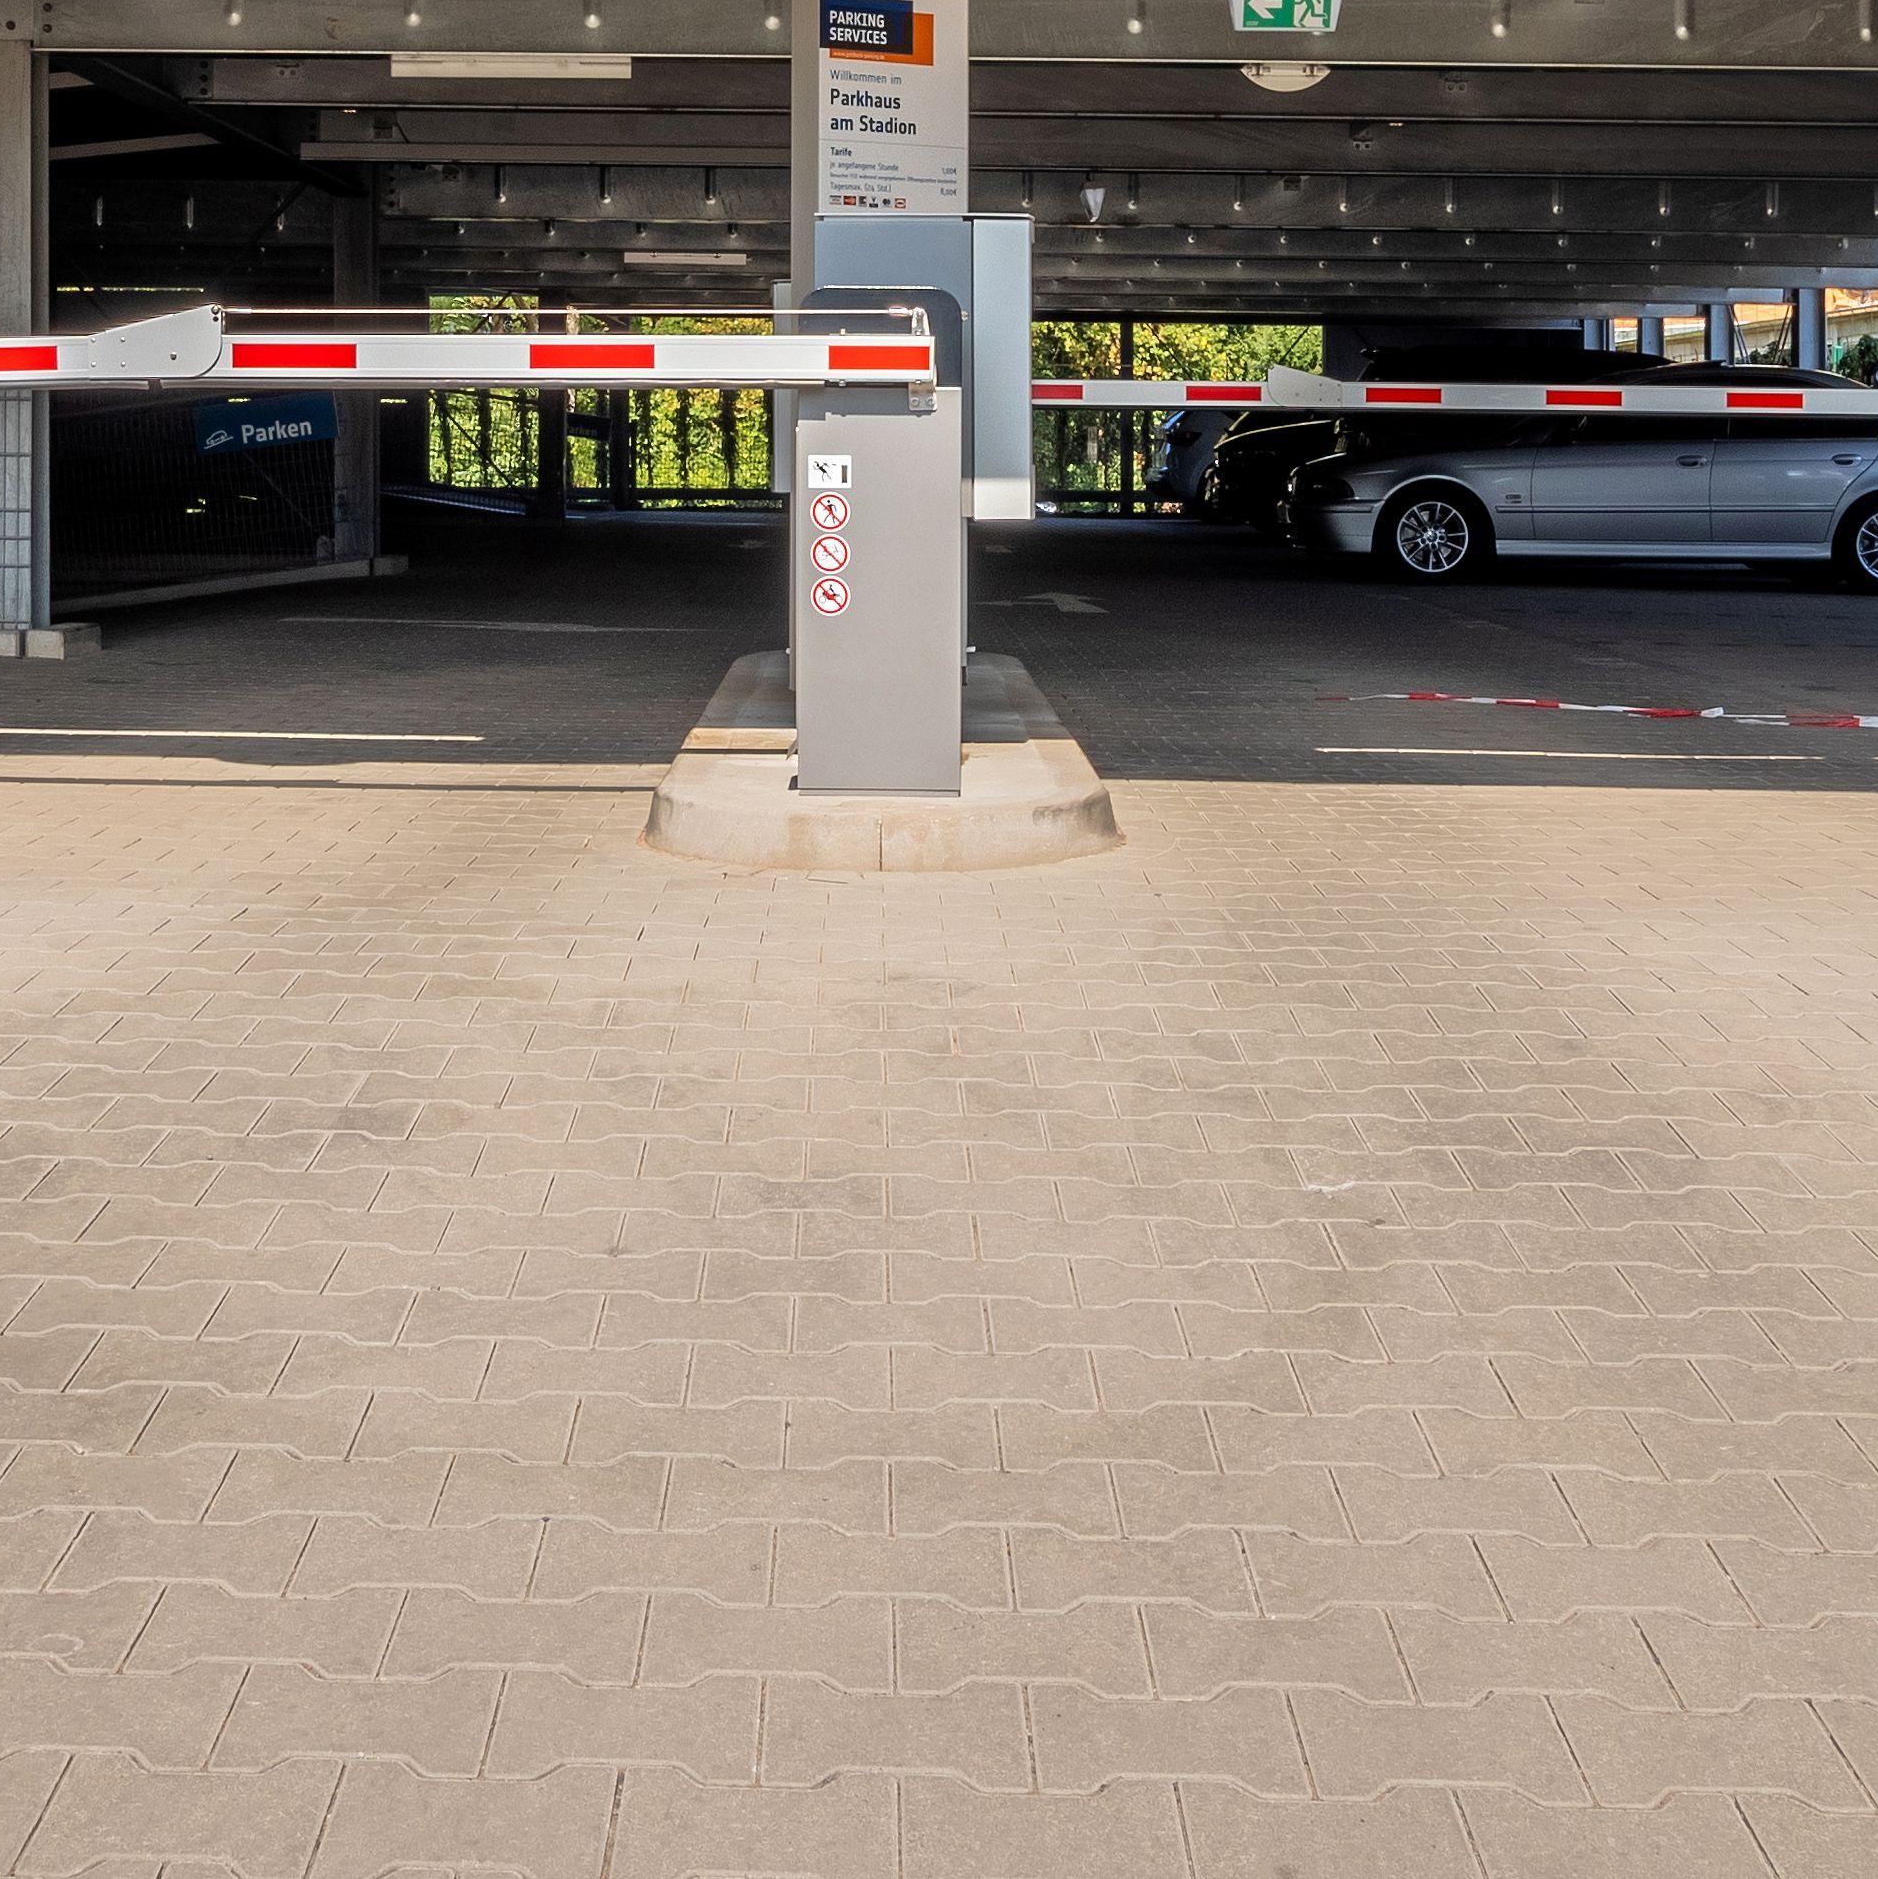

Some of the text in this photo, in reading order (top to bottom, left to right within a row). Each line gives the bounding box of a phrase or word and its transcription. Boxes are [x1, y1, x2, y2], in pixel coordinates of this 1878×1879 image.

[829, 10, 885, 29] PARKING
[829, 27, 888, 45] SERVICES
[830, 69, 902, 85] Willkommen im
[830, 88, 901, 110] Parkhaus
[830, 115, 917, 135] am Stadion
[830, 147, 852, 157] Tarife
[241, 420, 313, 444] Parken
